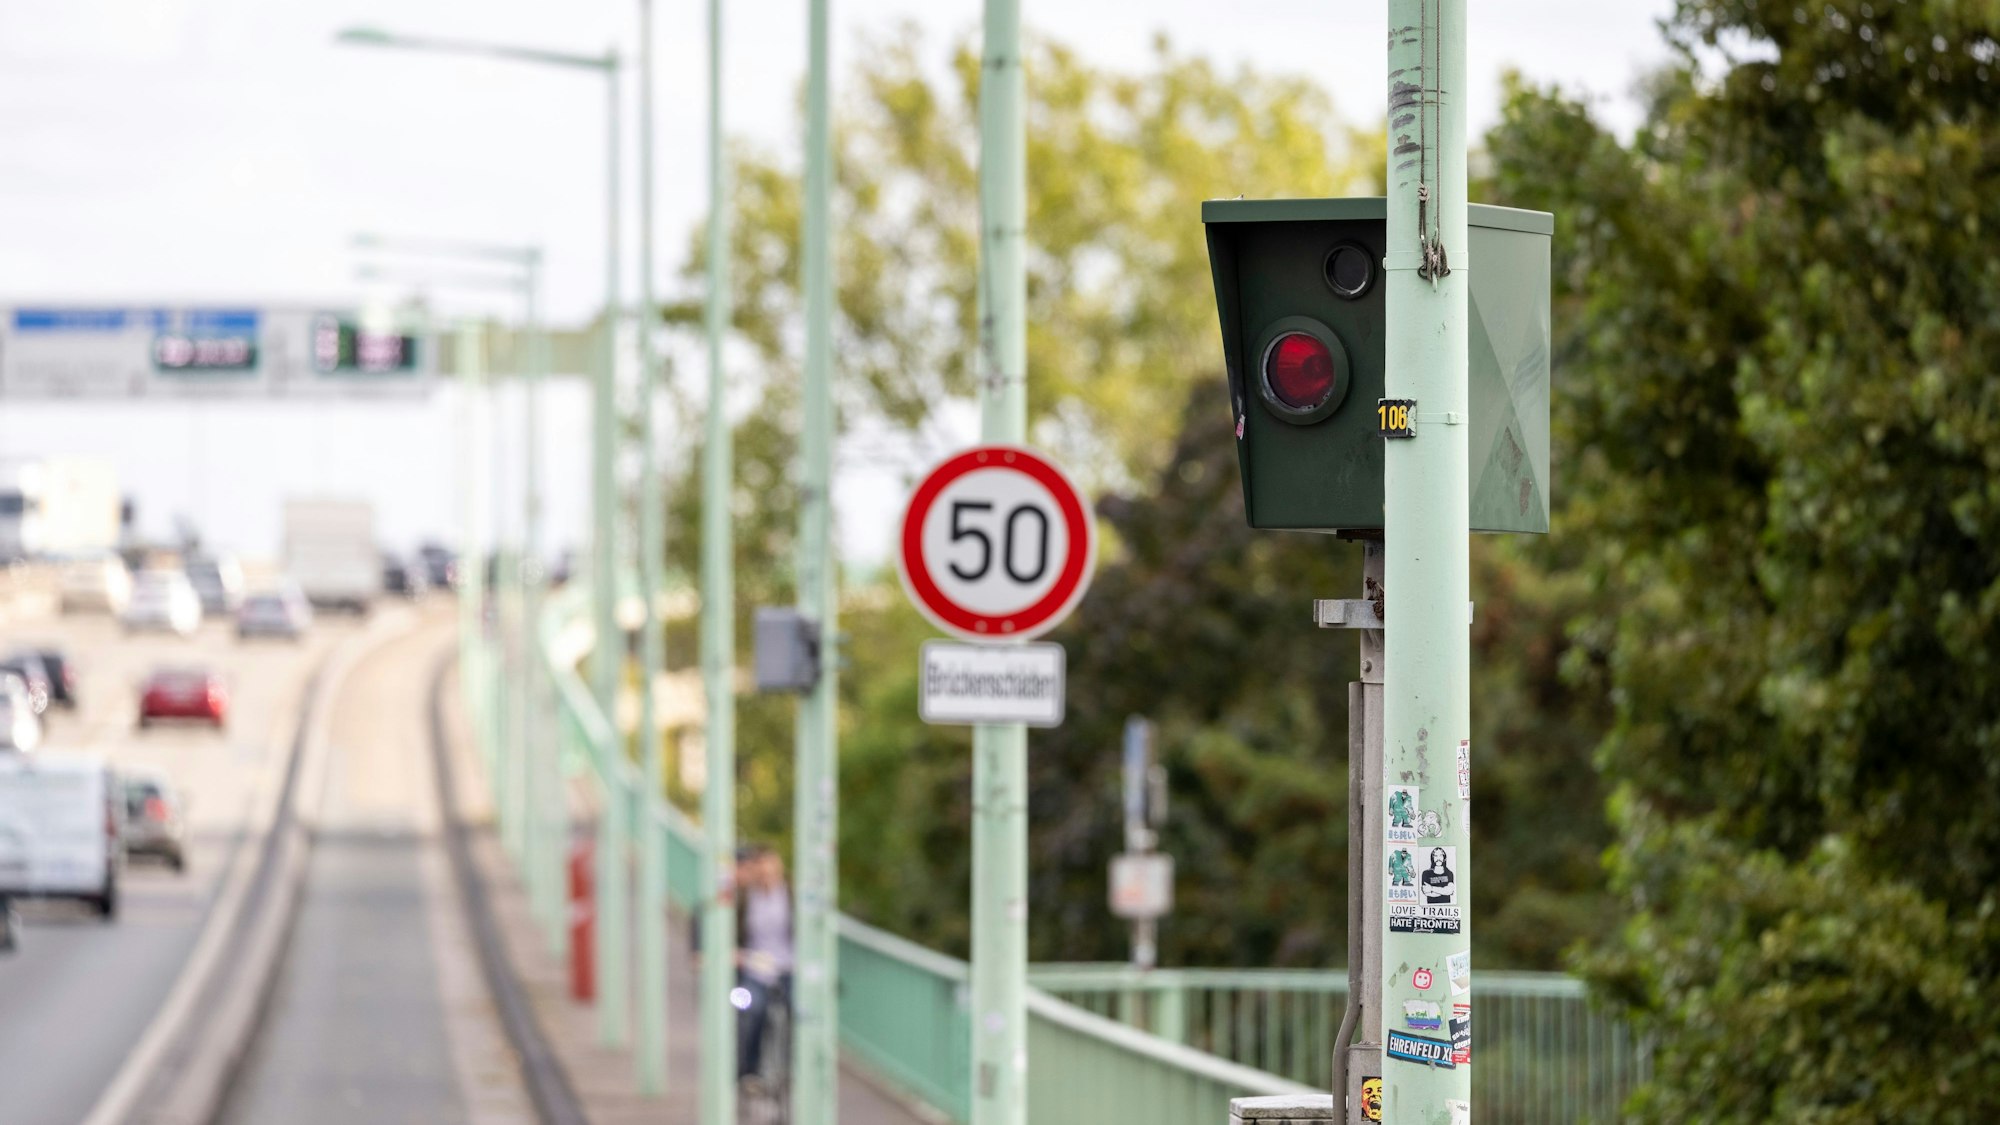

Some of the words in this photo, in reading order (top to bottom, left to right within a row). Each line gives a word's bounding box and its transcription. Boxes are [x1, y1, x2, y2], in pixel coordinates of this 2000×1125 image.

[1378, 405, 1407, 430] 106
[948, 501, 1048, 584] 50
[1391, 905, 1416, 915] LOVE
[1421, 907, 1459, 917] TRAILS
[1391, 918, 1412, 928] HATE
[1414, 919, 1459, 930] FRONTEX
[1389, 1036, 1440, 1060] EHRENFELD
